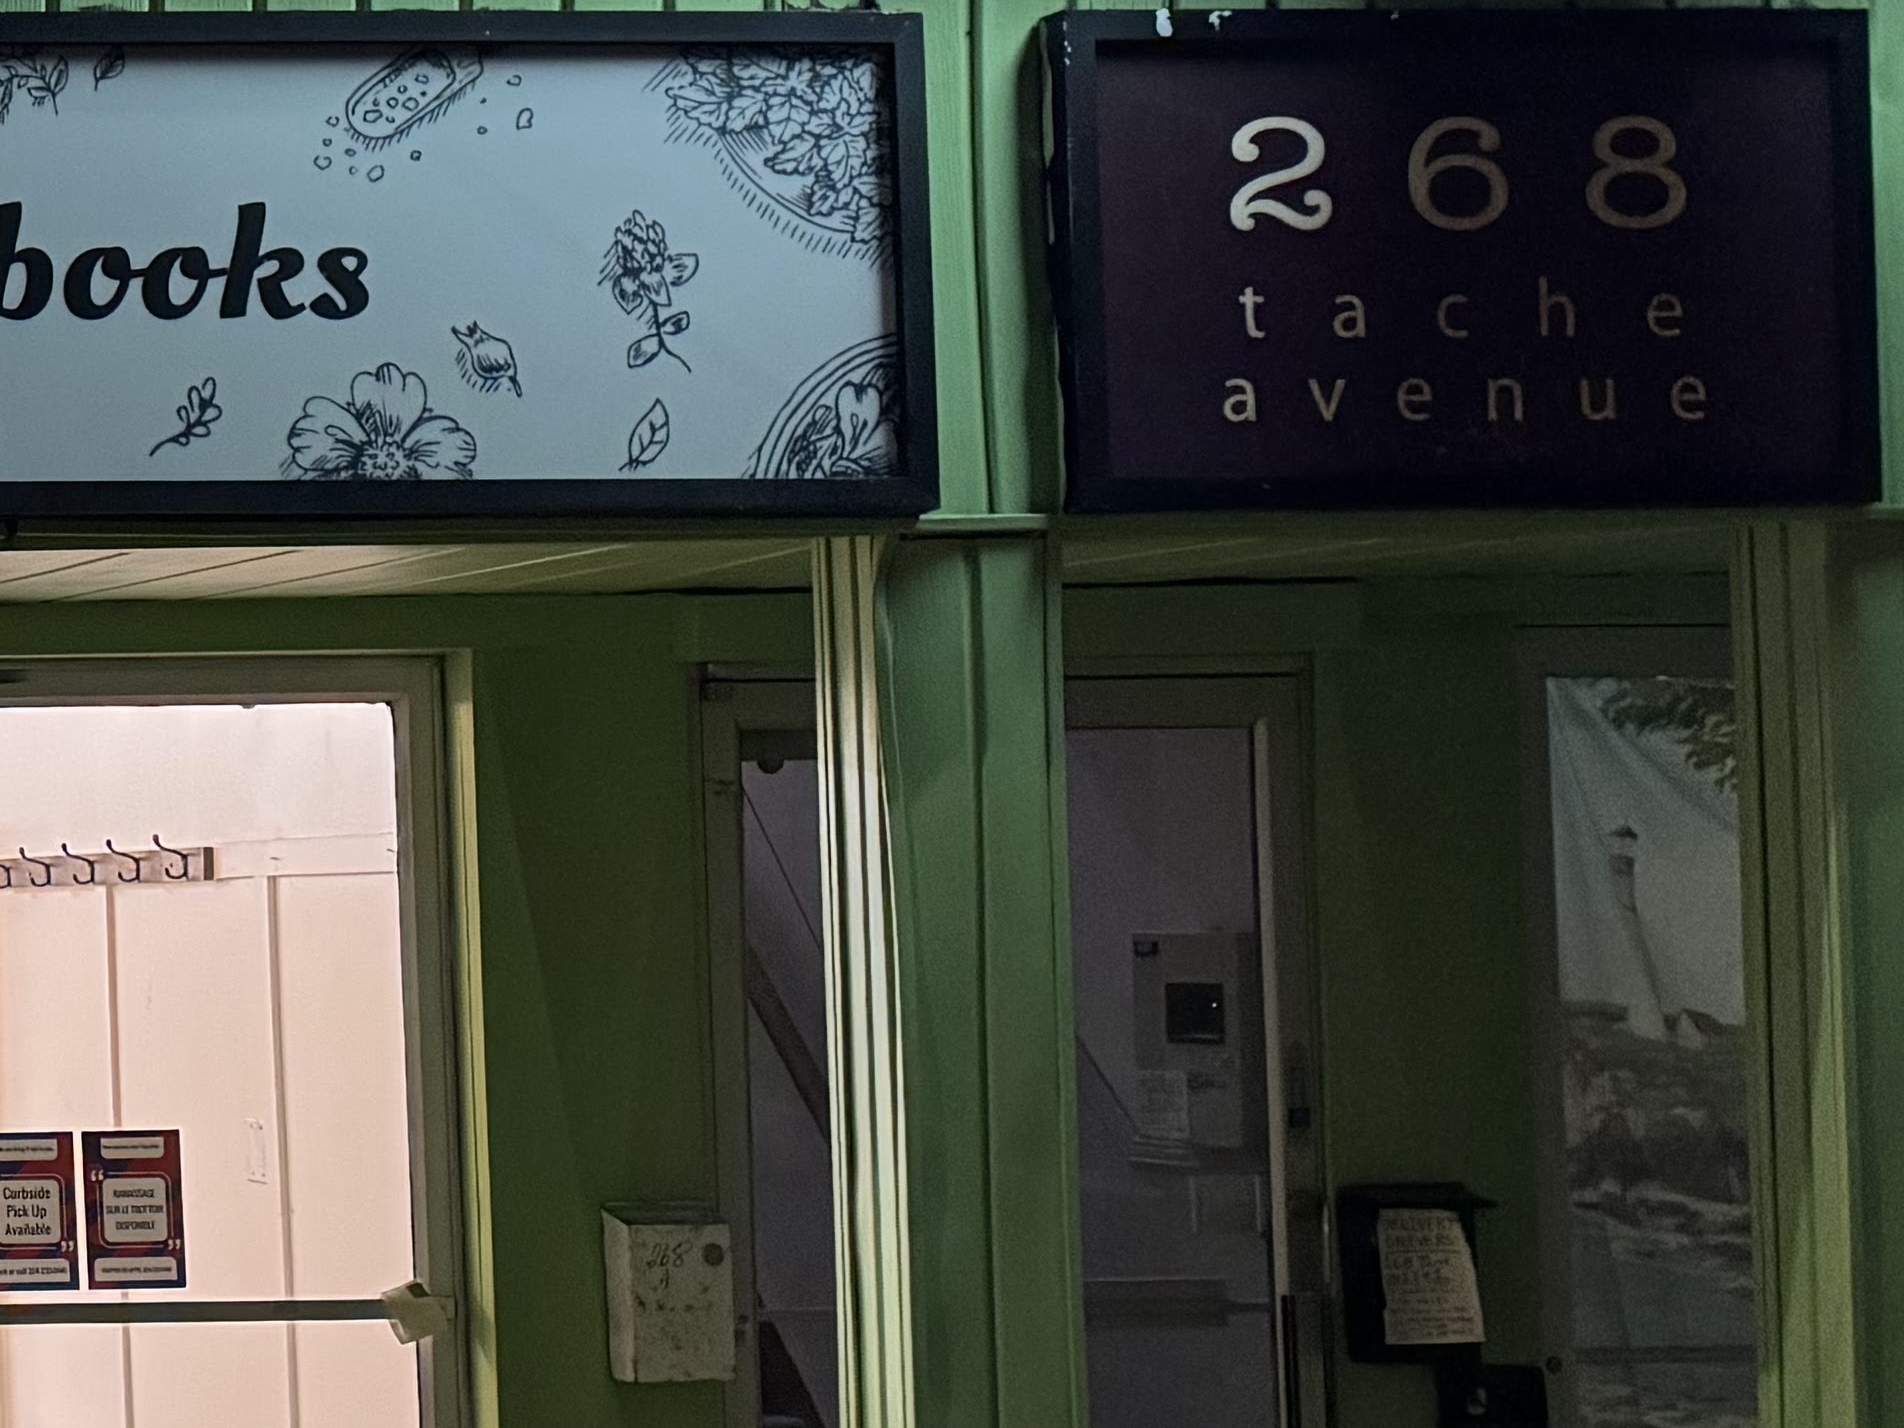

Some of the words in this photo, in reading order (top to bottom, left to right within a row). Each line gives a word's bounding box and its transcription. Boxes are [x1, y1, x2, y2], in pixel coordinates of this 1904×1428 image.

[1229, 115, 1687, 232] 268
[1238, 276, 1684, 339] tache
[1222, 376, 1708, 423] avenue
[2, 1186, 51, 1200] Curbside
[6, 1204, 29, 1218] Pick
[31, 1204, 47, 1220] Up
[5, 1222, 52, 1236] Available
